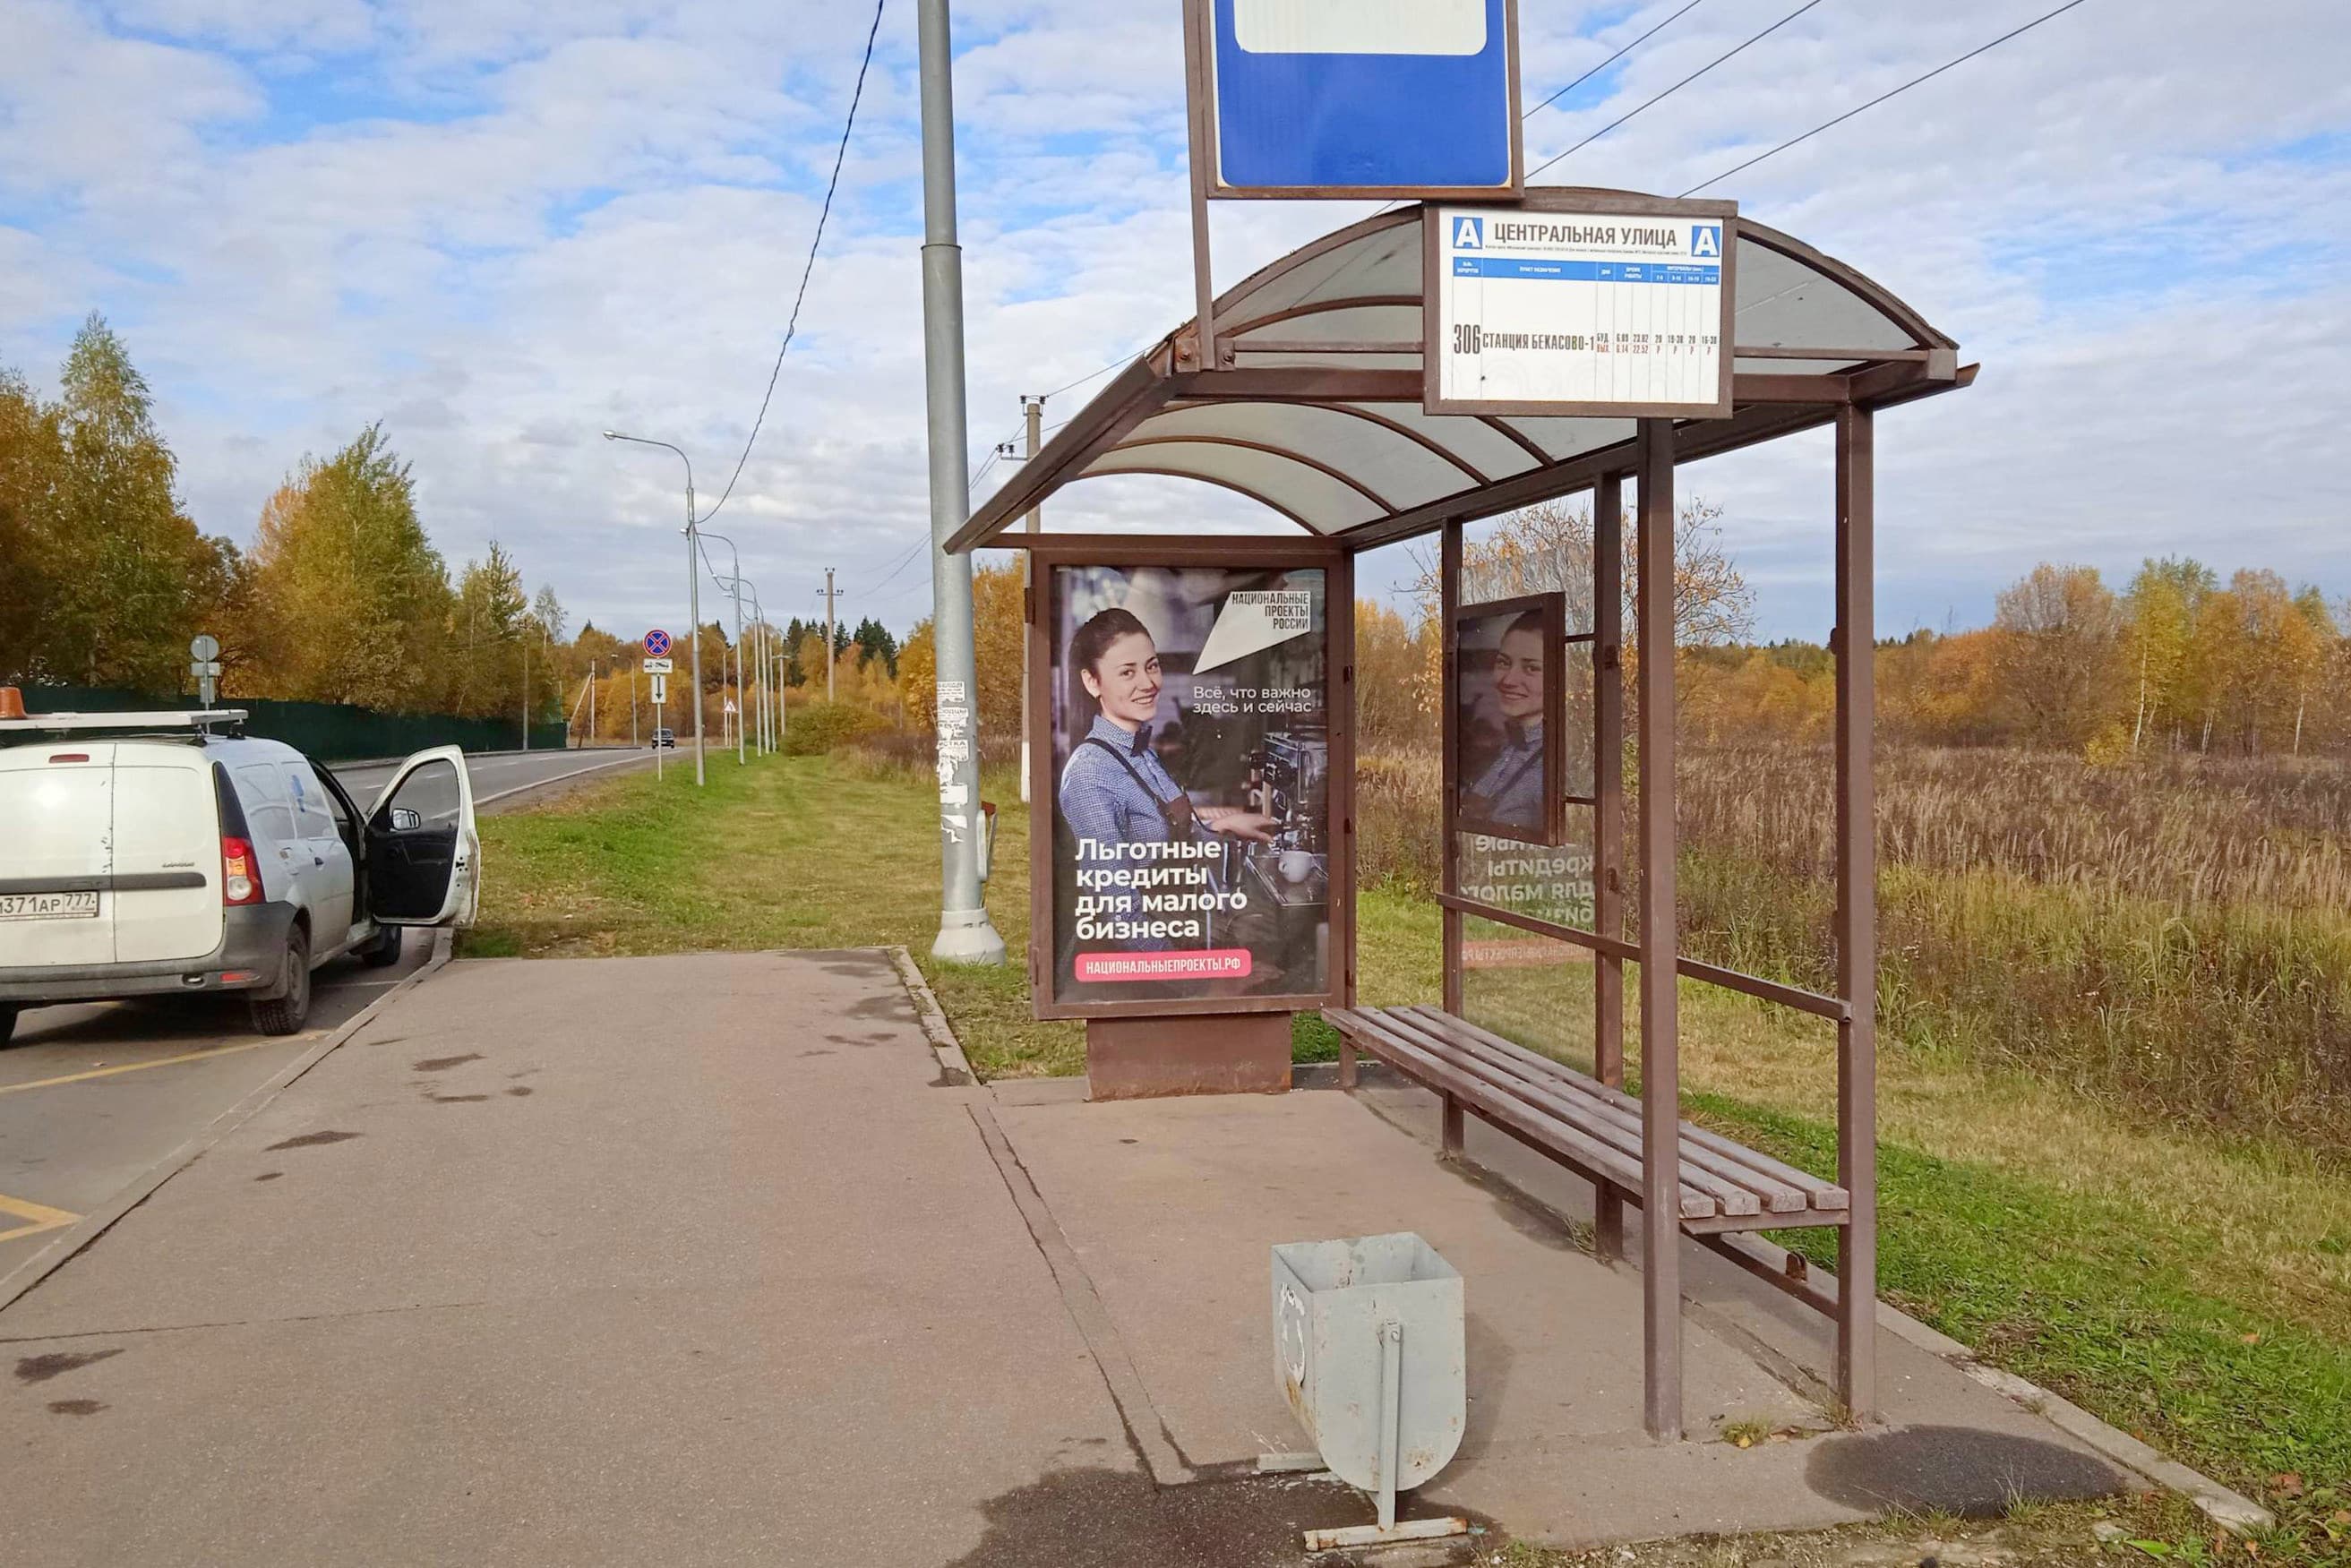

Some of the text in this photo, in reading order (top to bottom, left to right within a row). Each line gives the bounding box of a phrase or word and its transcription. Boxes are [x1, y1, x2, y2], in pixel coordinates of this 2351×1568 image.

[1494, 223, 1677, 249] ЦЕНТРАЛЬНАЯ УЛИЦА
[1454, 324, 1481, 355] 306
[1482, 332, 1595, 351] СТАНЦИЯ БЕКАСОВО-1
[1231, 593, 1309, 605] НАЦИОНАЛЬНЫЕ
[1265, 605, 1309, 617] ПРОЕКТЫ
[1273, 618, 1309, 630] РОССИИ
[1193, 686, 1311, 700] Всё, что важно
[1192, 698, 1312, 715] здесь и сейчас
[1075, 838, 1222, 861] Льготные
[1077, 867, 1207, 892] кредиты
[1075, 892, 1248, 917] для малого
[1076, 915, 1200, 940] бизнеса
[1085, 956, 1241, 976] НАЦИОНАЛЬНЫЕПРОЕКТЫ.РФ
